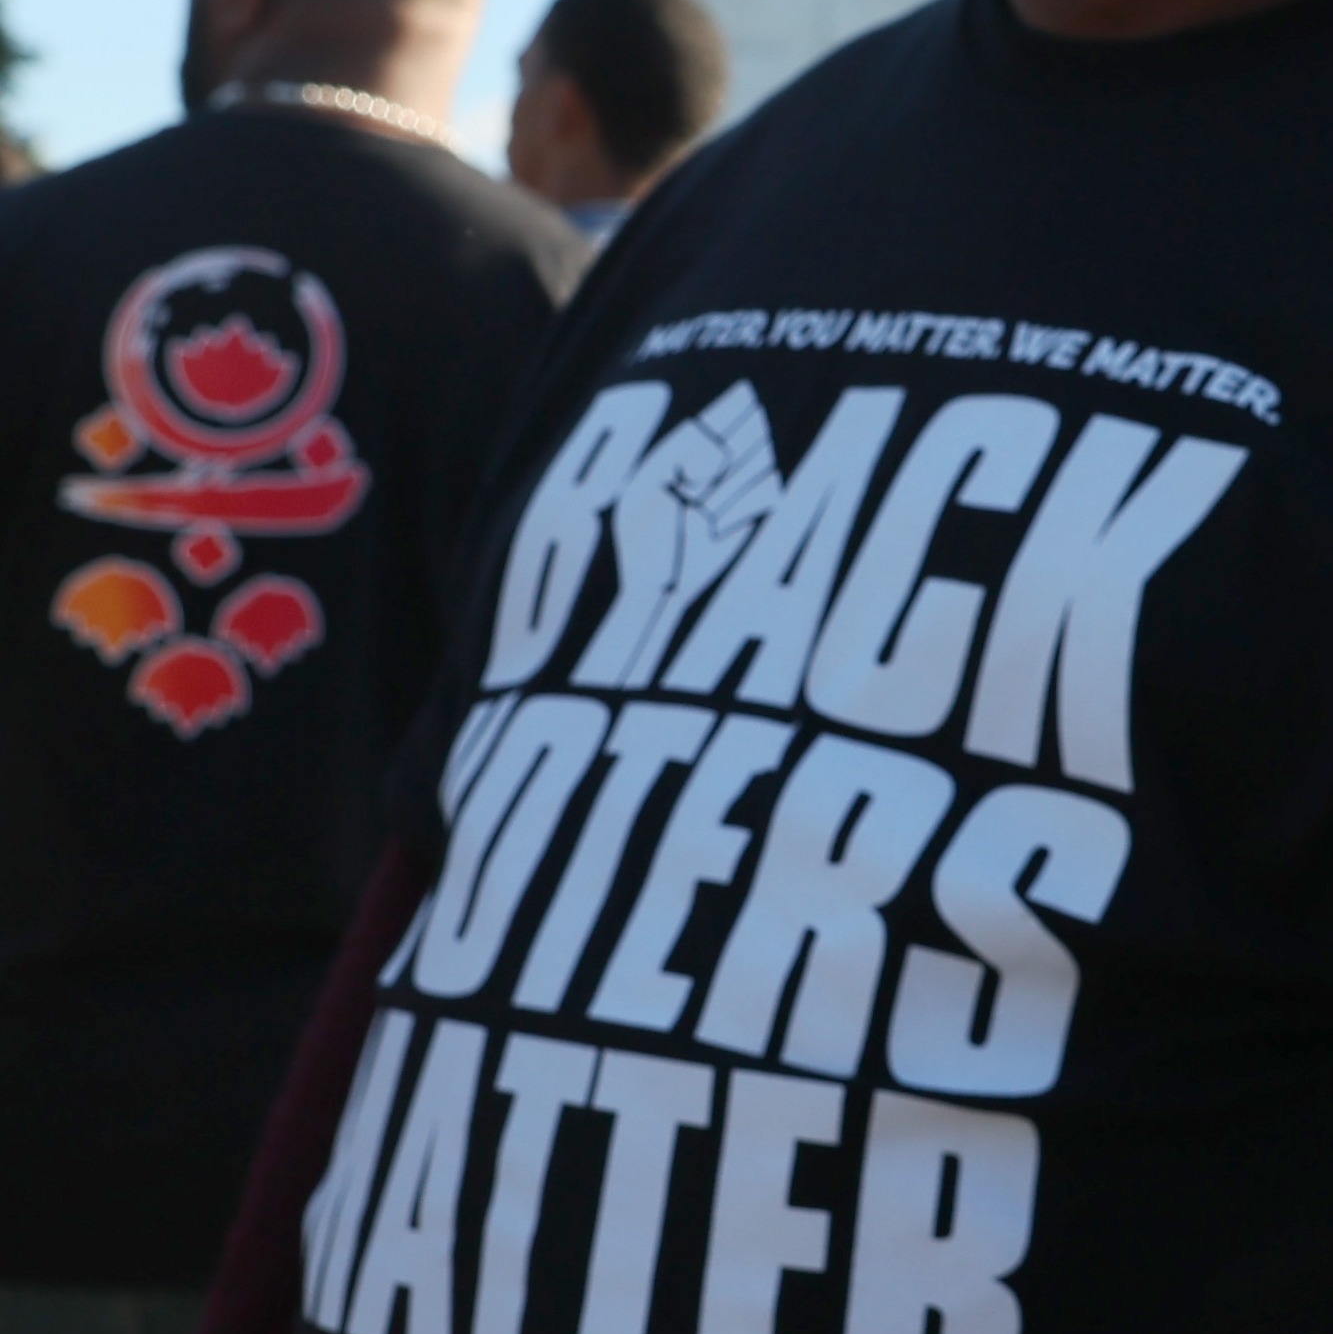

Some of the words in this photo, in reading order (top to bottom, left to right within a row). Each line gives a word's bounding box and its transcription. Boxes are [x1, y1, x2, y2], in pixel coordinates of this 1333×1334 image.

[768, 307, 854, 352] YOU
[1007, 320, 1092, 370] WE
[1080, 335, 1282, 427] MATTER.
[480, 378, 1250, 794] BACK
